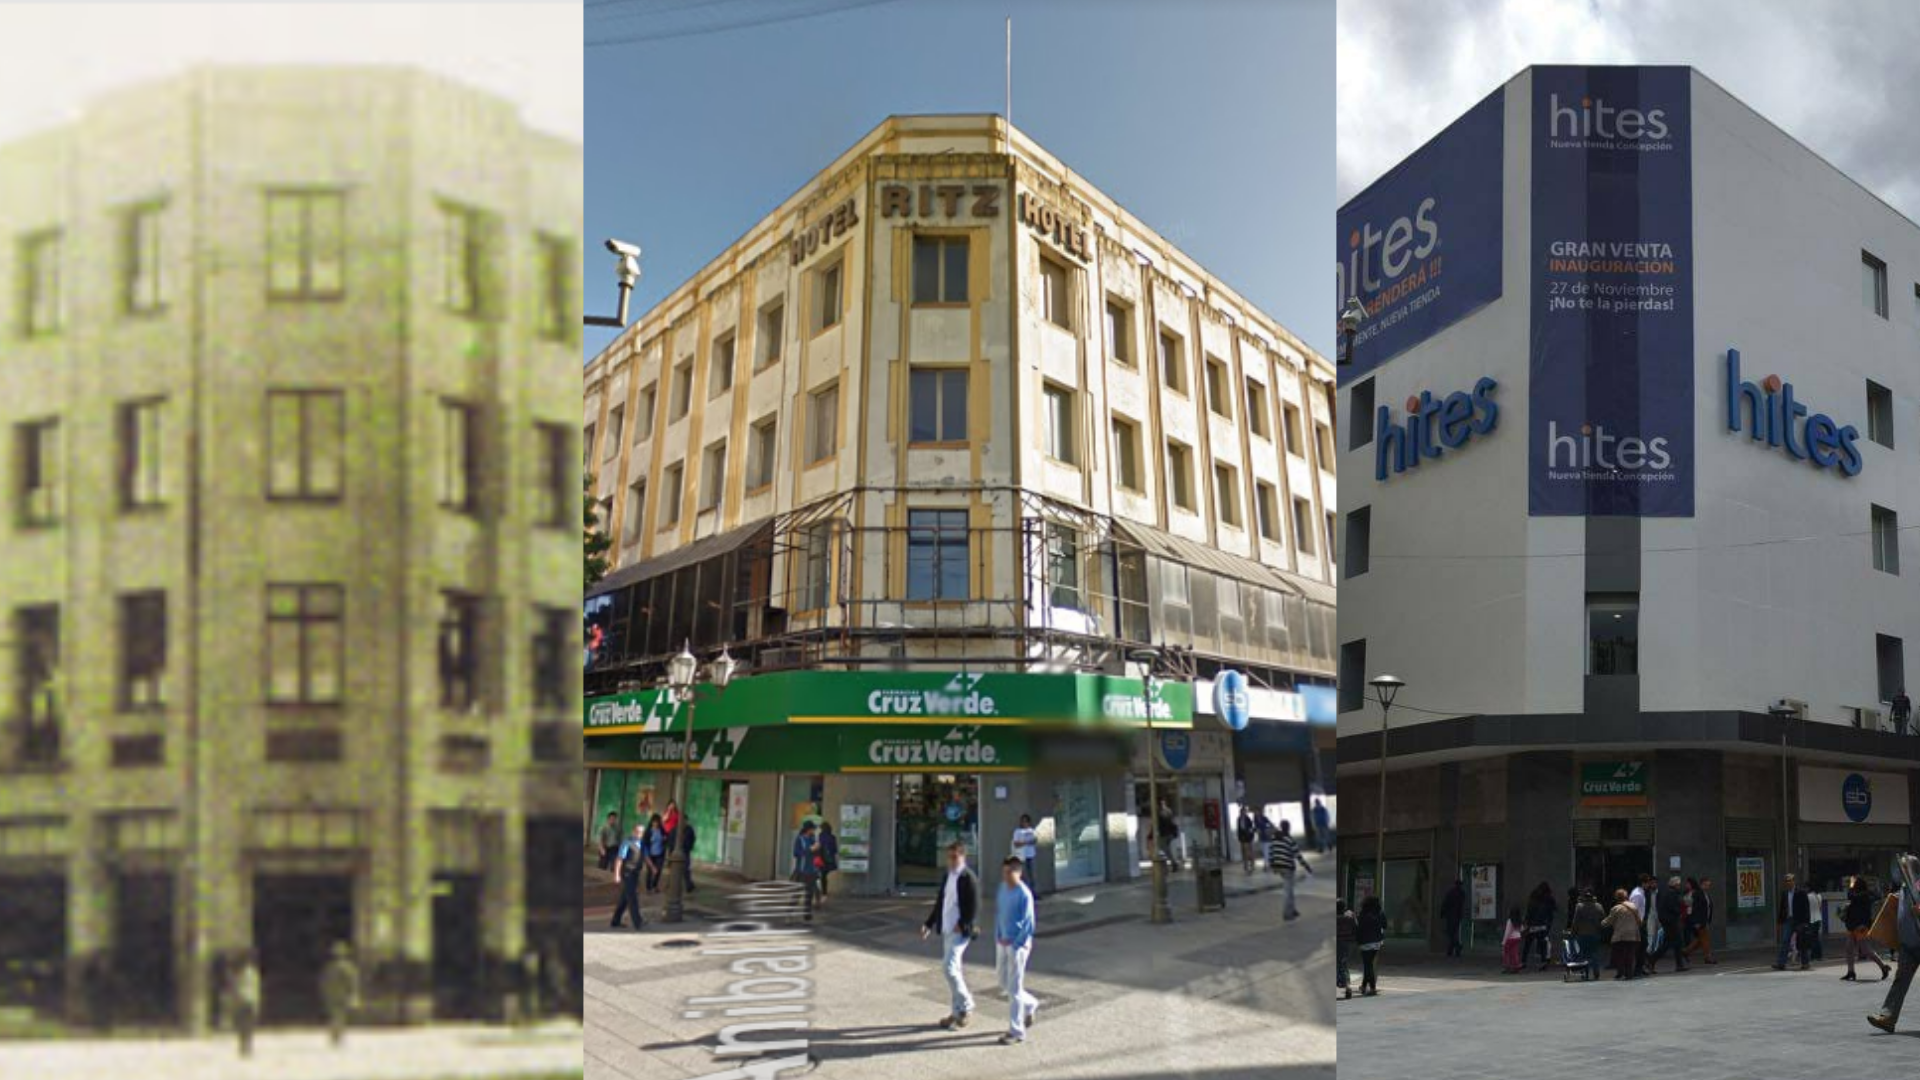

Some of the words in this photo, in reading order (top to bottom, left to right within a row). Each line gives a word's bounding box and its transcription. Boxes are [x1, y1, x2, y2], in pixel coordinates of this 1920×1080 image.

[1550, 93, 1669, 139] hites
[1550, 140, 1581, 148] Nueva
[881, 184, 1000, 218] RITZ
[789, 197, 859, 267] HOTEL
[1018, 192, 1093, 263] HOTEL
[1550, 241, 1606, 257] GRAN
[1610, 243, 1673, 258] VENTA
[1550, 282, 1567, 294] 27
[1571, 282, 1590, 294] de
[1594, 283, 1674, 296] Noviembre
[1550, 297, 1575, 311] ¡No
[1579, 298, 1593, 309] te
[1597, 298, 1611, 309] la
[1614, 299, 1674, 313] pierdas!
[1727, 348, 1863, 477] hites
[1376, 377, 1499, 481] hites
[1549, 420, 1671, 470] hites
[1549, 471, 1580, 480] Nueva
[590, 701, 612, 726] Cruz
[868, 689, 922, 715] Cruz
[1102, 694, 1132, 717] Cruz
[640, 739, 663, 760] Cruz
[869, 739, 923, 764] Cruz
[1583, 782, 1609, 792] Cruz
[1609, 781, 1642, 792] Verde
